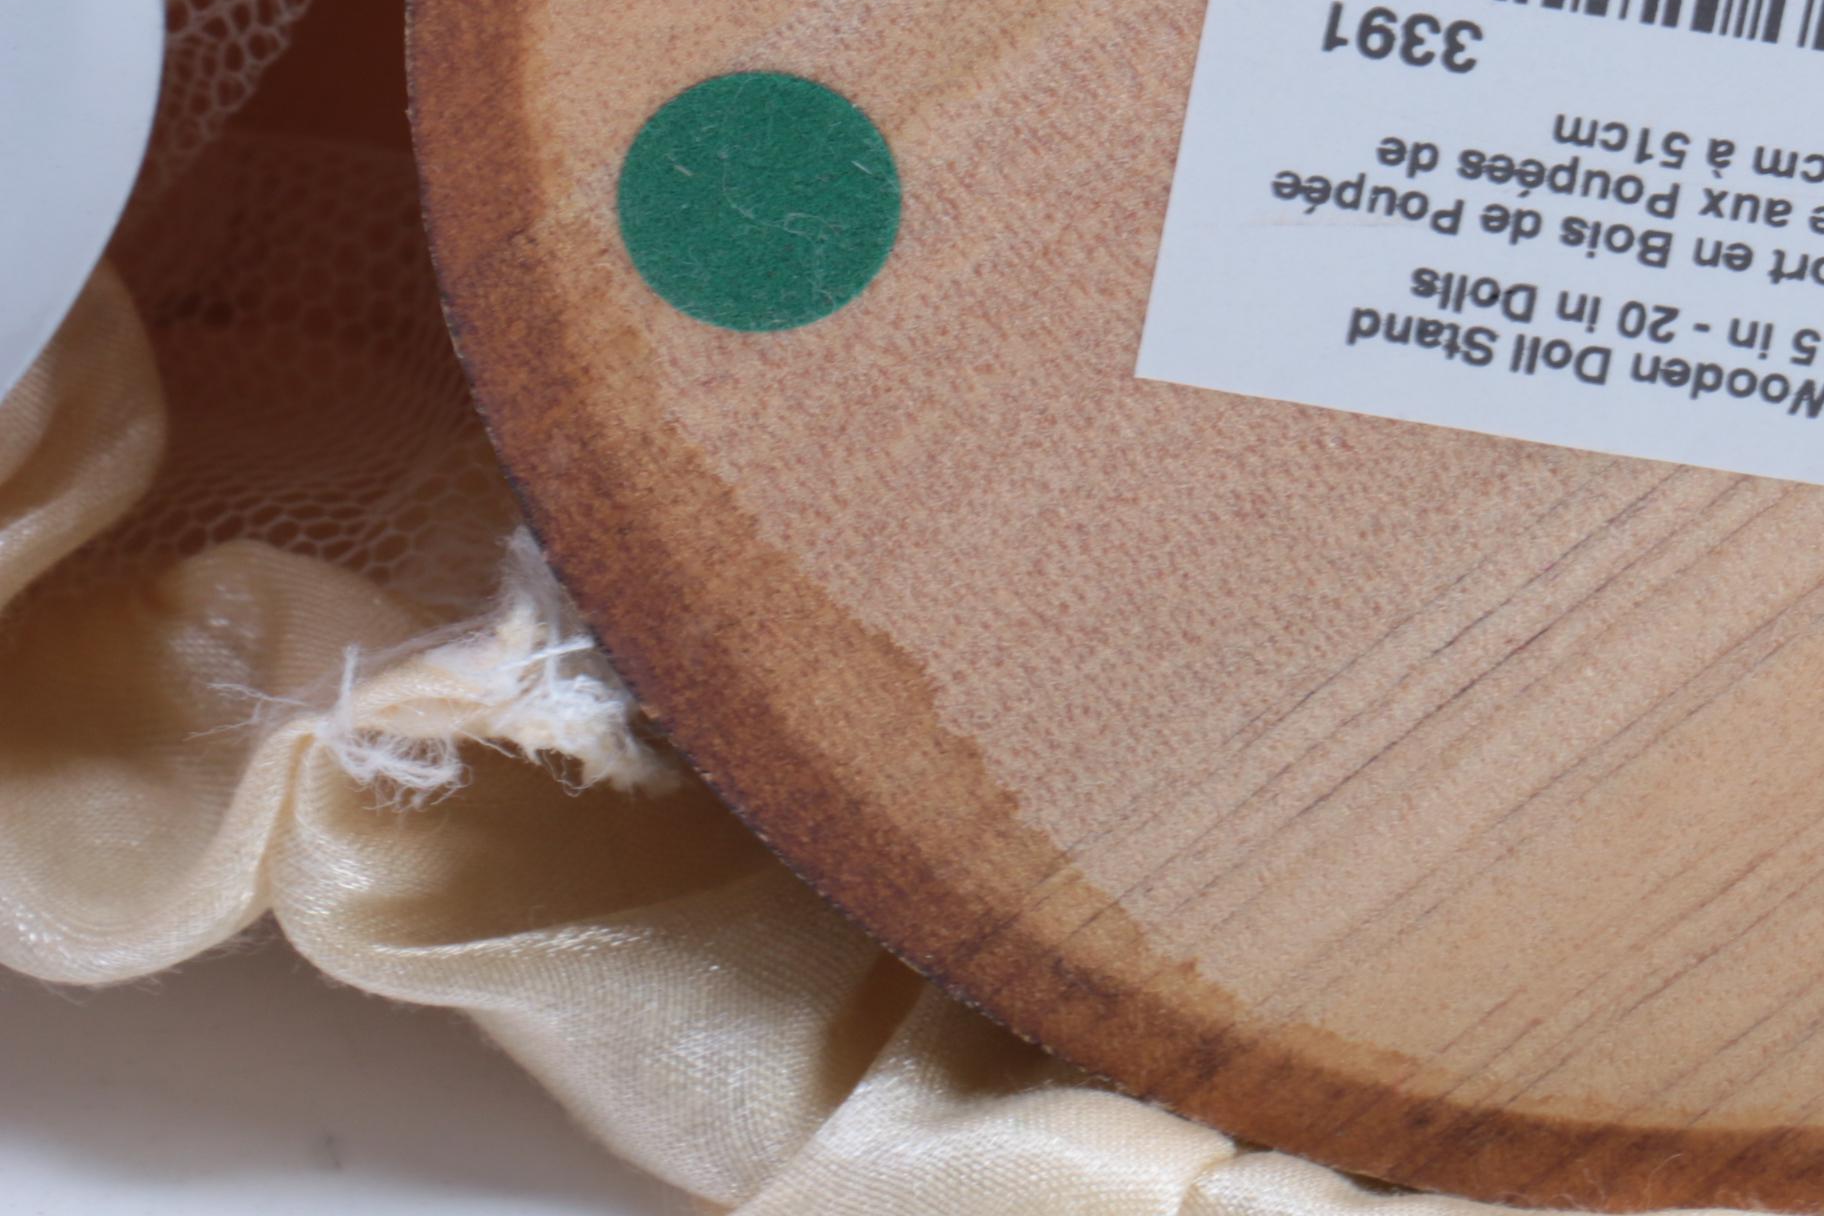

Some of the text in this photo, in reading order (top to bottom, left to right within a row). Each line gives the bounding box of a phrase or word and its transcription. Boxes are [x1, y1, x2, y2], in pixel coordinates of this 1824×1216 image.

[1320, 0, 1484, 75] 3391
[1374, 134, 1441, 180] de
[1551, 112, 1692, 171] 51cm
[1704, 136, 1737, 180] à
[1269, 168, 1466, 237] Poupée
[1455, 147, 1682, 221] Poupées
[1697, 185, 1794, 229] aux
[1478, 201, 1544, 246] de
[1558, 214, 1675, 270] Bois
[1691, 235, 1755, 273] en
[1409, 265, 1539, 325] Dolls
[1554, 288, 1602, 335] in
[1344, 305, 1500, 368] Stand
[1615, 298, 1681, 345] 20
[1691, 320, 1712, 334] -
[1726, 316, 1775, 361] in
[1508, 331, 1613, 387] Doll
